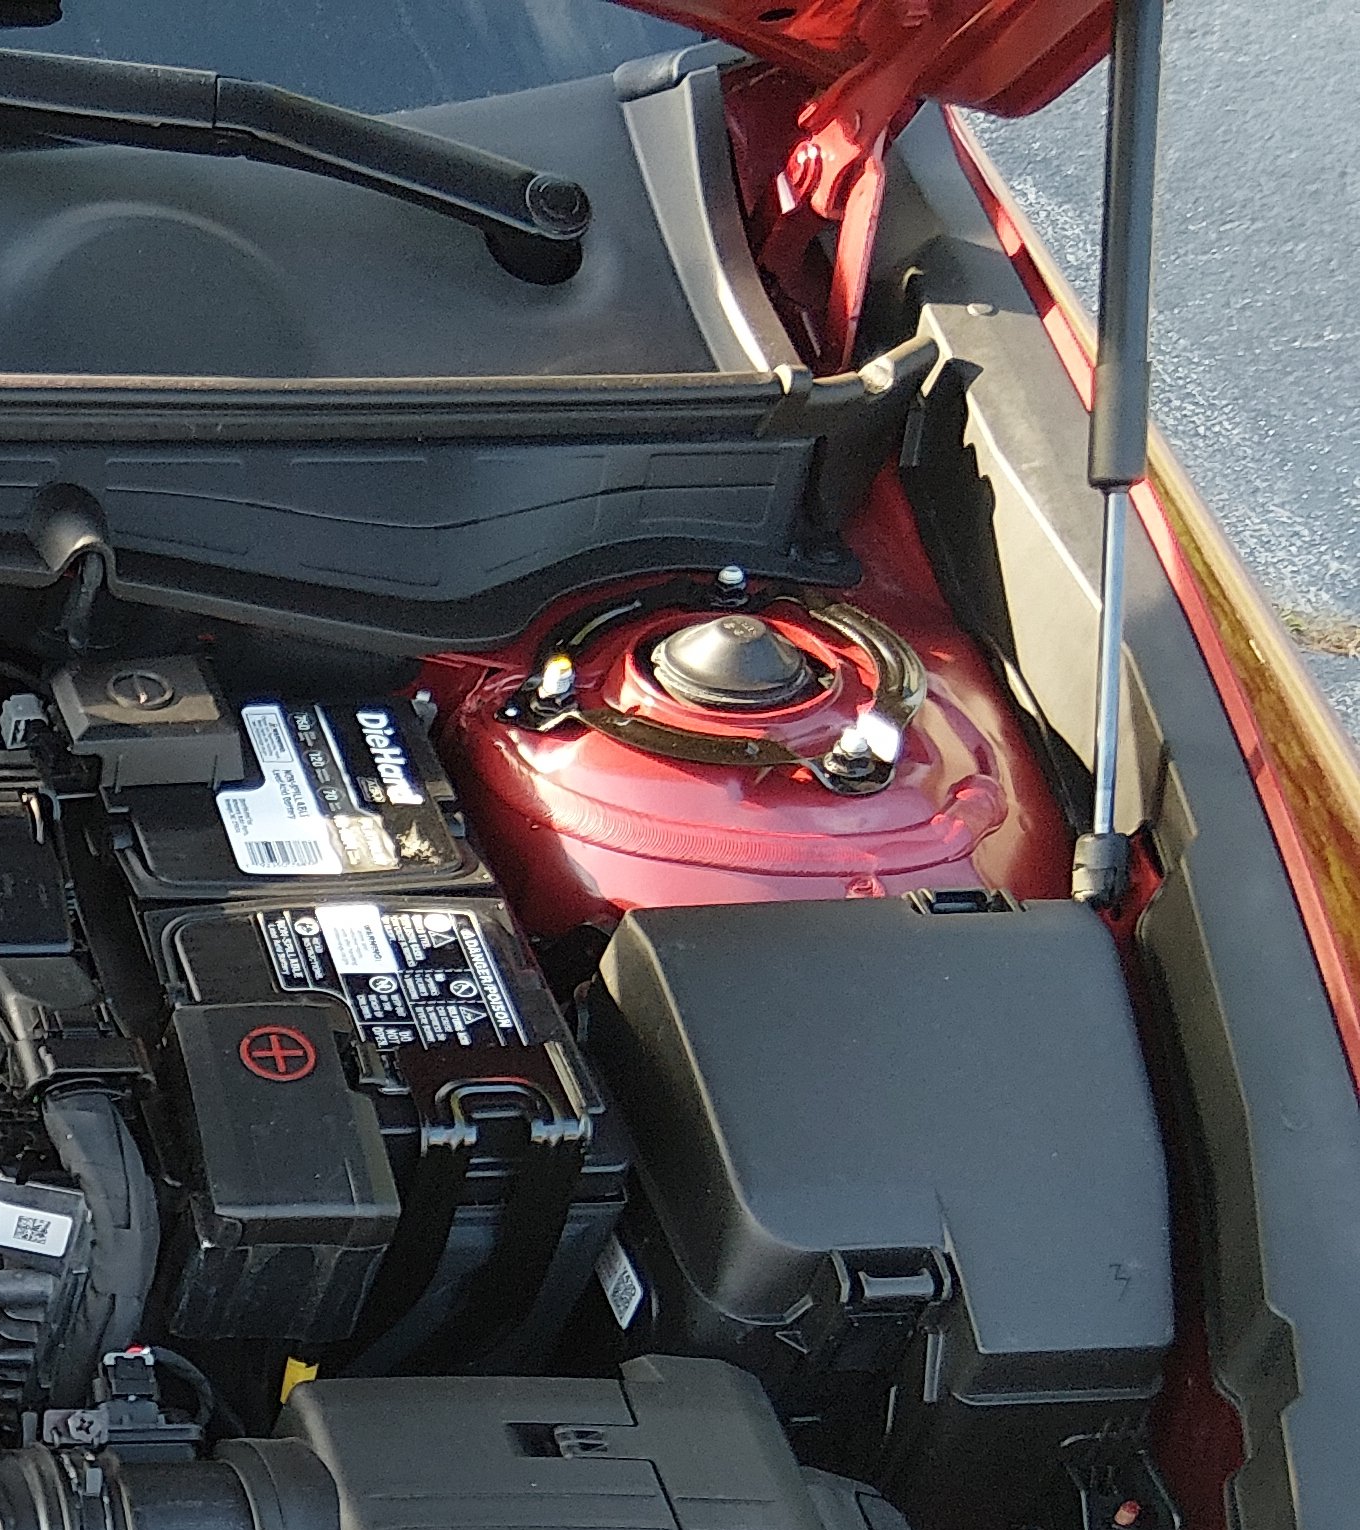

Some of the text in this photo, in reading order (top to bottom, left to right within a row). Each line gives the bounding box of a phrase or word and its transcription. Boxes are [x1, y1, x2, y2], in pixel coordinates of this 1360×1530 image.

[307, 752, 326, 766] 120
[356, 712, 423, 804] DieHard
[466, 939, 512, 1028] DANGER/POISON
[384, 1029, 401, 1043] NOT
[396, 1030, 414, 1041] DO
